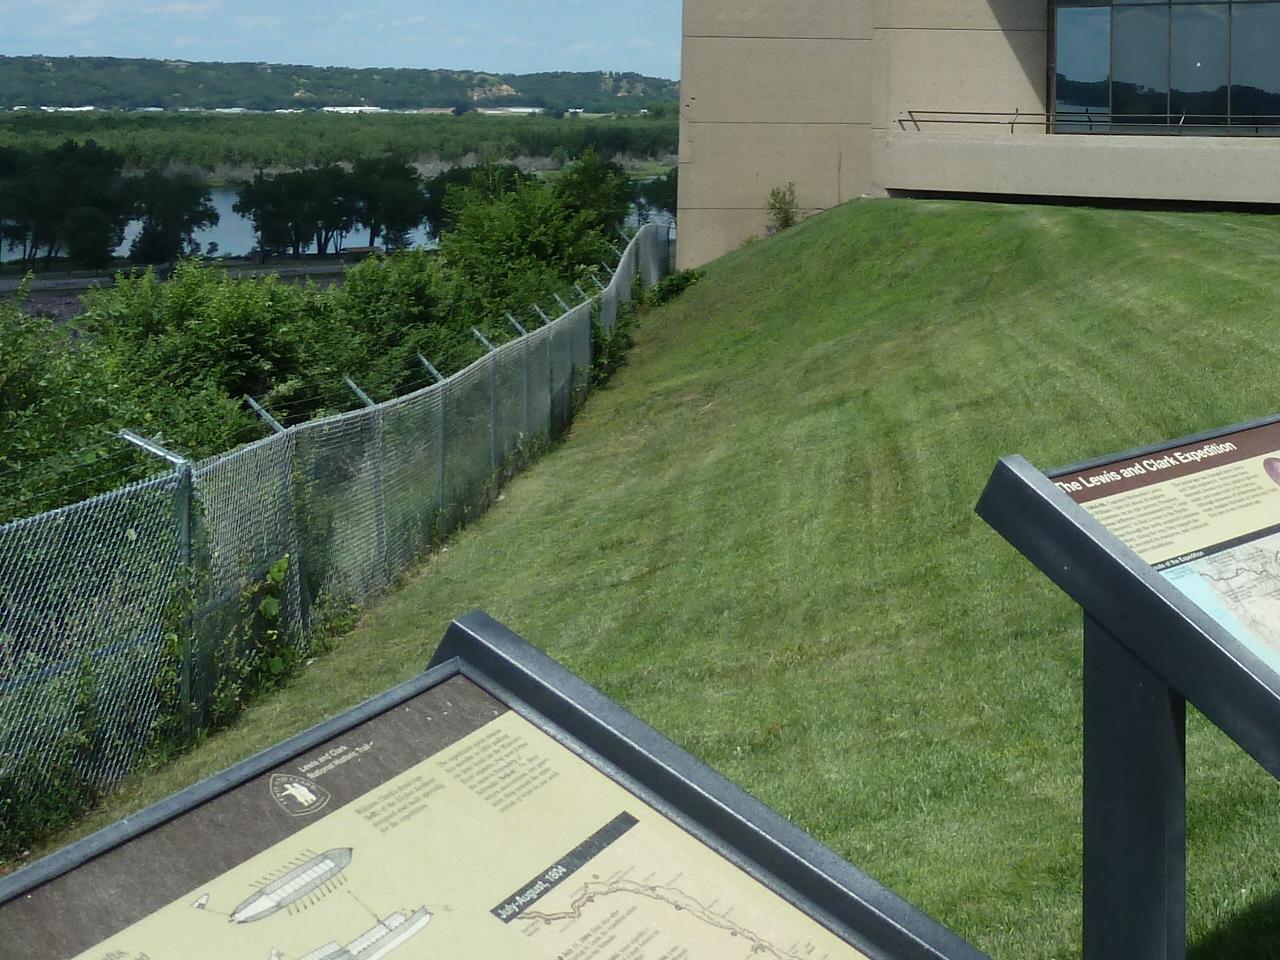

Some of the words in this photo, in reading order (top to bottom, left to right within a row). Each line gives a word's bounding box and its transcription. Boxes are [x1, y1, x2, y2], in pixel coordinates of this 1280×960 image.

[1055, 481, 1082, 493] The
[1079, 470, 1121, 488] Lewis
[1120, 464, 1146, 479] and
[1142, 455, 1180, 471] Clark
[1173, 441, 1237, 463] Expedition
[498, 880, 551, 919] July-August,
[544, 865, 567, 881] 1804
